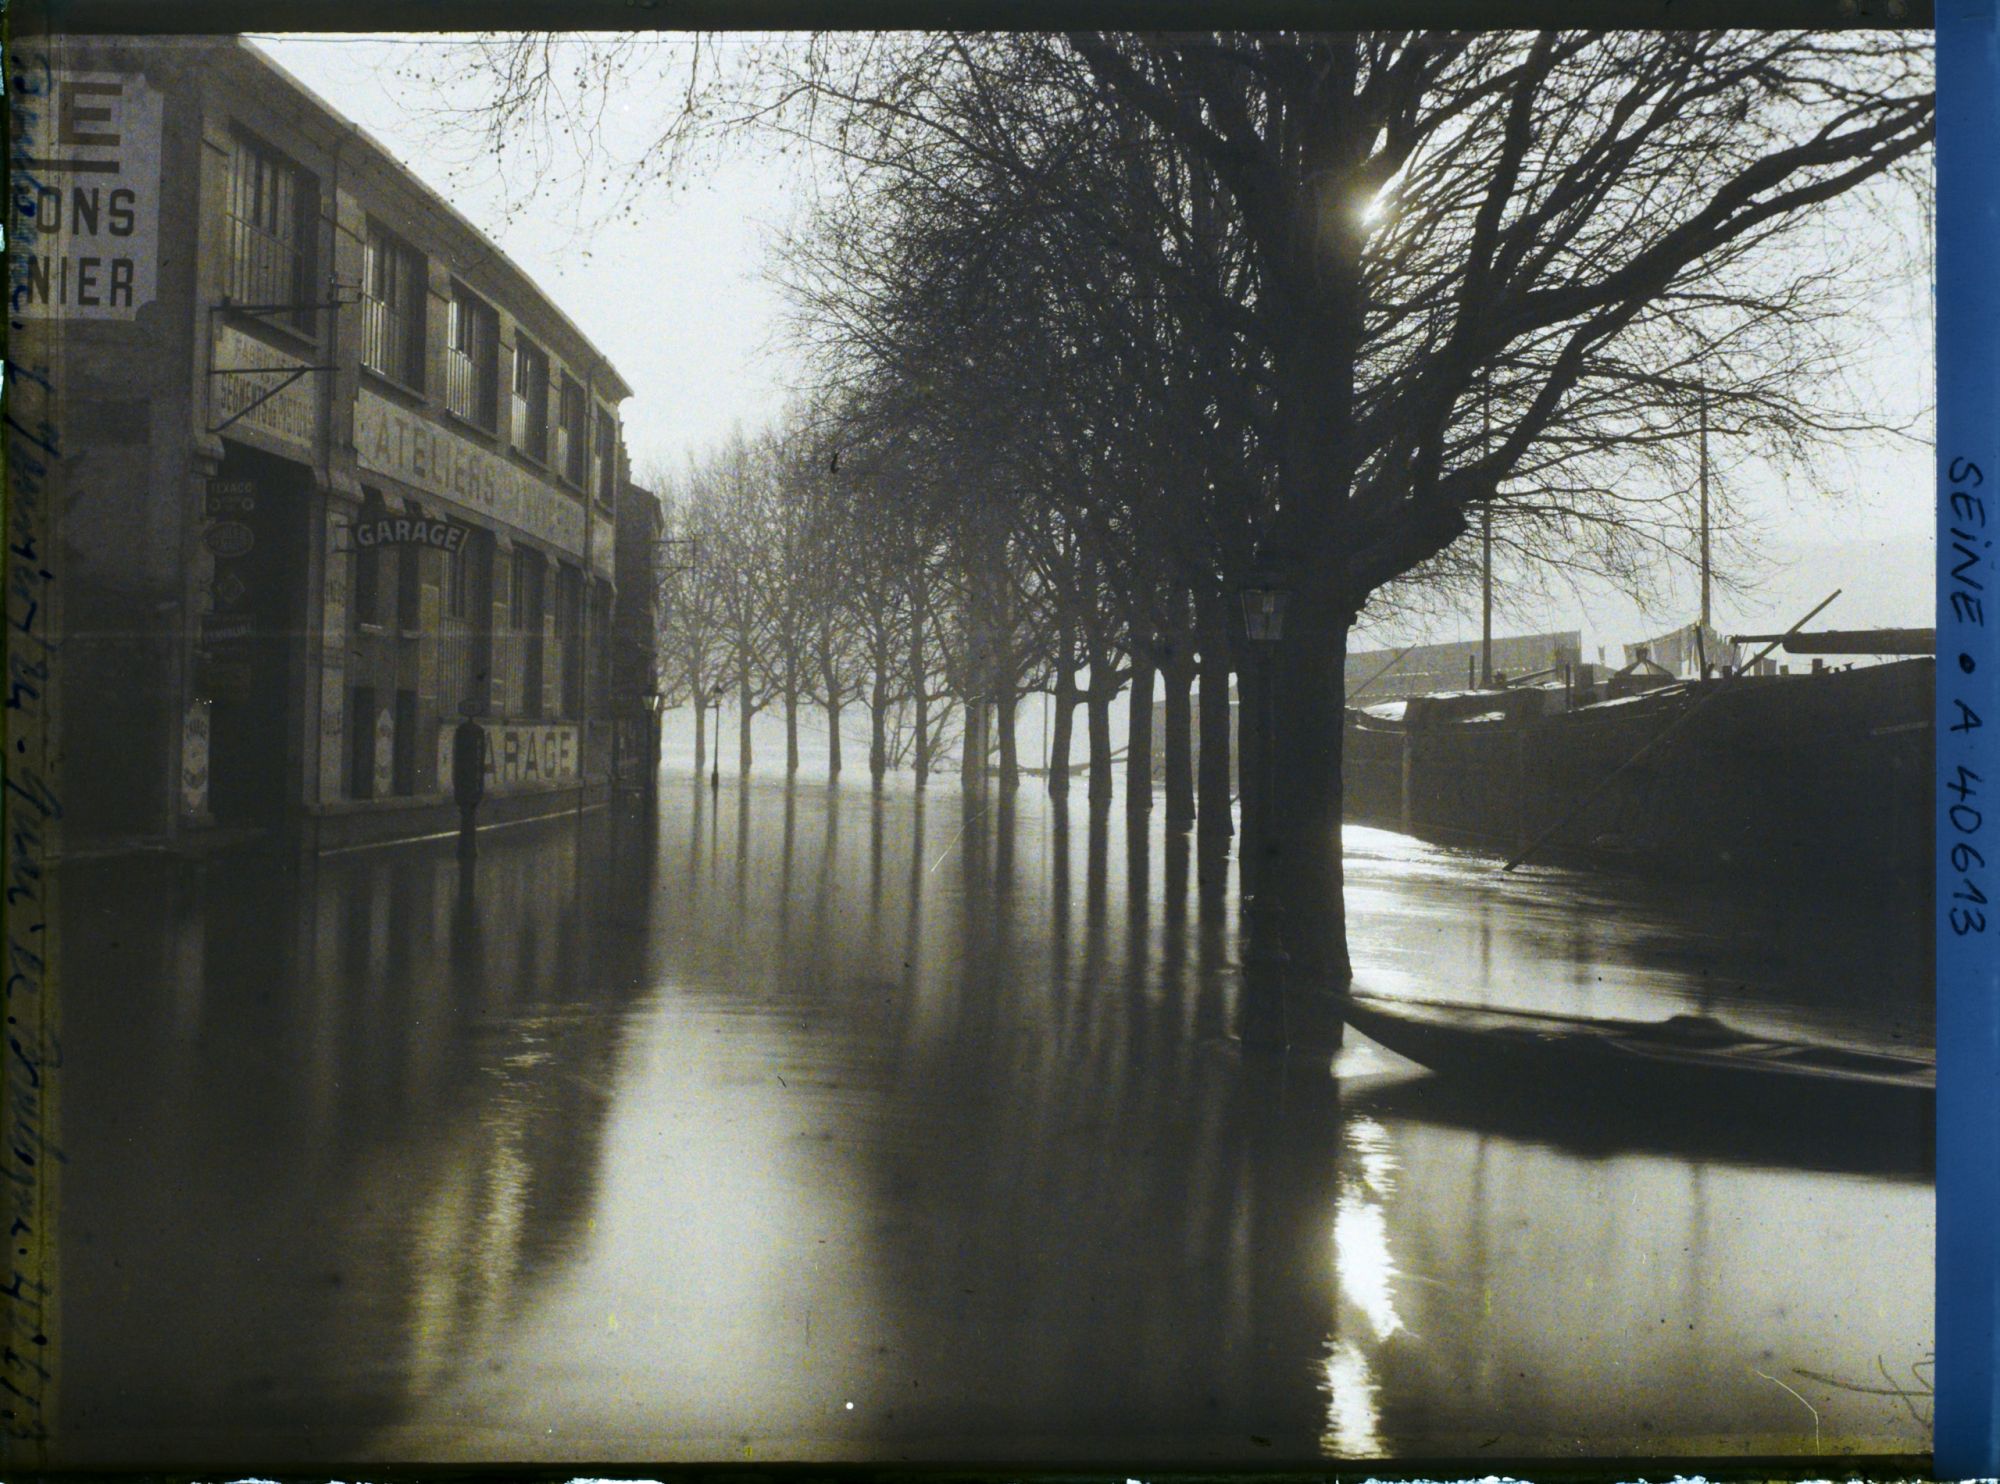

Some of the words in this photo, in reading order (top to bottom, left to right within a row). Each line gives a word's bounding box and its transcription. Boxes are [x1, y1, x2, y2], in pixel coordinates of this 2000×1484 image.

[375, 412, 496, 506] ATELIERS
[356, 519, 462, 551] GARAGE
[1951, 698, 1983, 735] A
[482, 730, 572, 784] ARAGE
[1946, 764, 1989, 937] 40613
